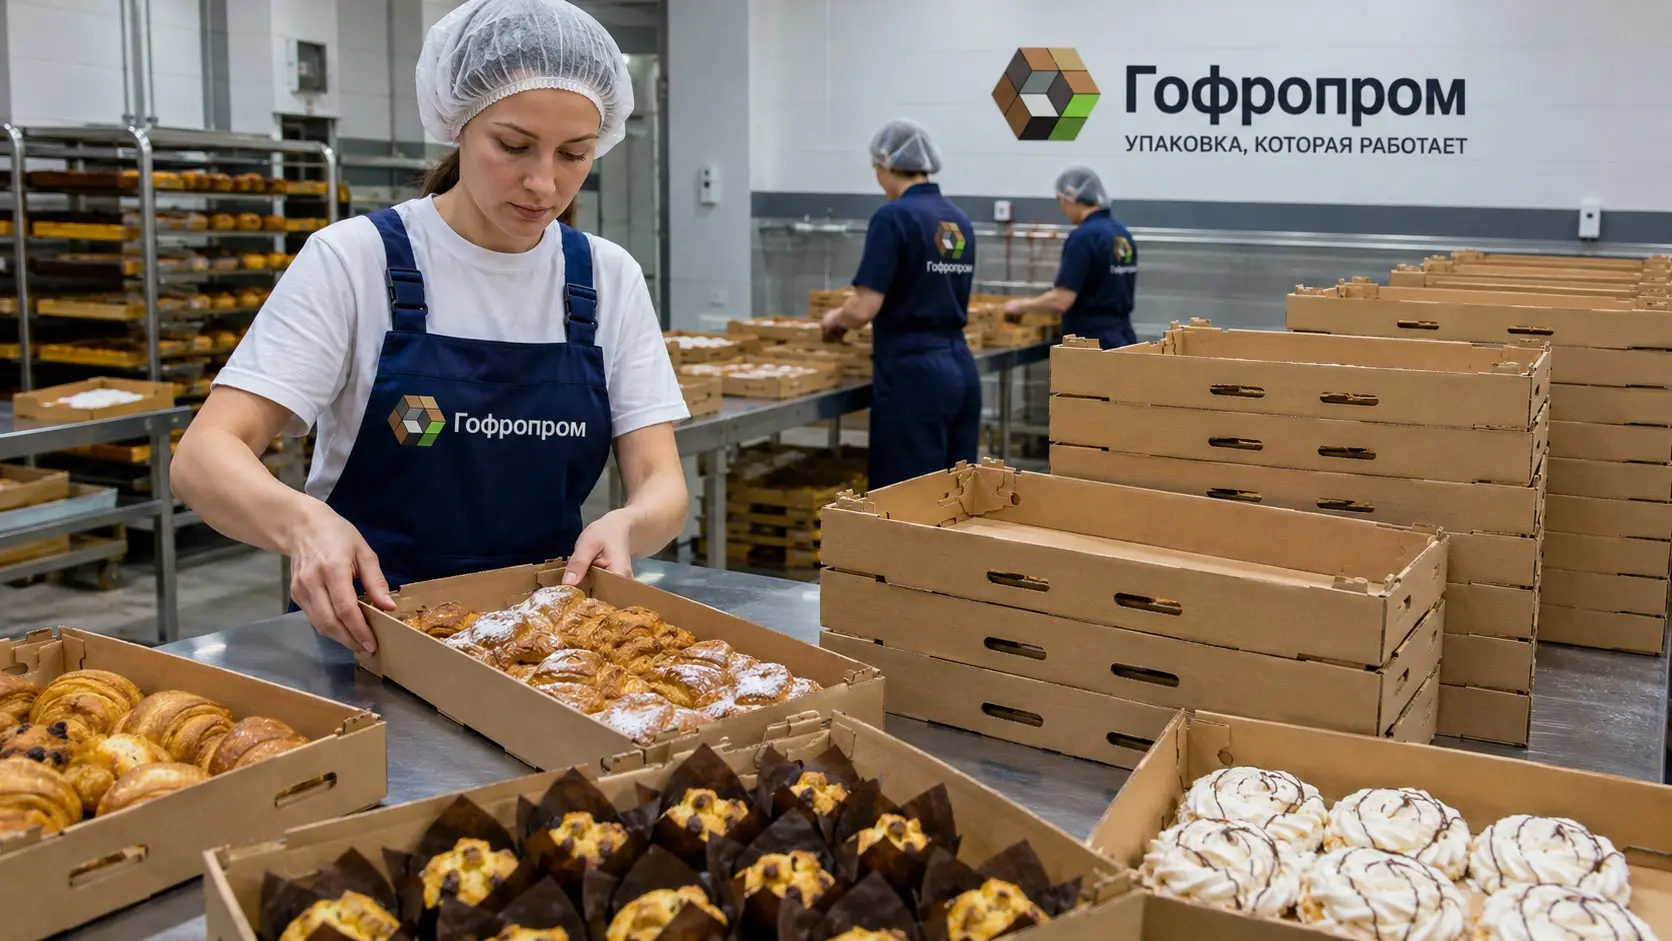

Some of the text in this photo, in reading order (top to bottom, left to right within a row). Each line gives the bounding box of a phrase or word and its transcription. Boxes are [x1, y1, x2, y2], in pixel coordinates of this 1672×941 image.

[1125, 64, 1467, 126] Гофропром
[1124, 135, 1468, 155] УПАКОВКА, КОТОРАЯ РАБОТАЕТ
[453, 412, 587, 440] Гофропром
